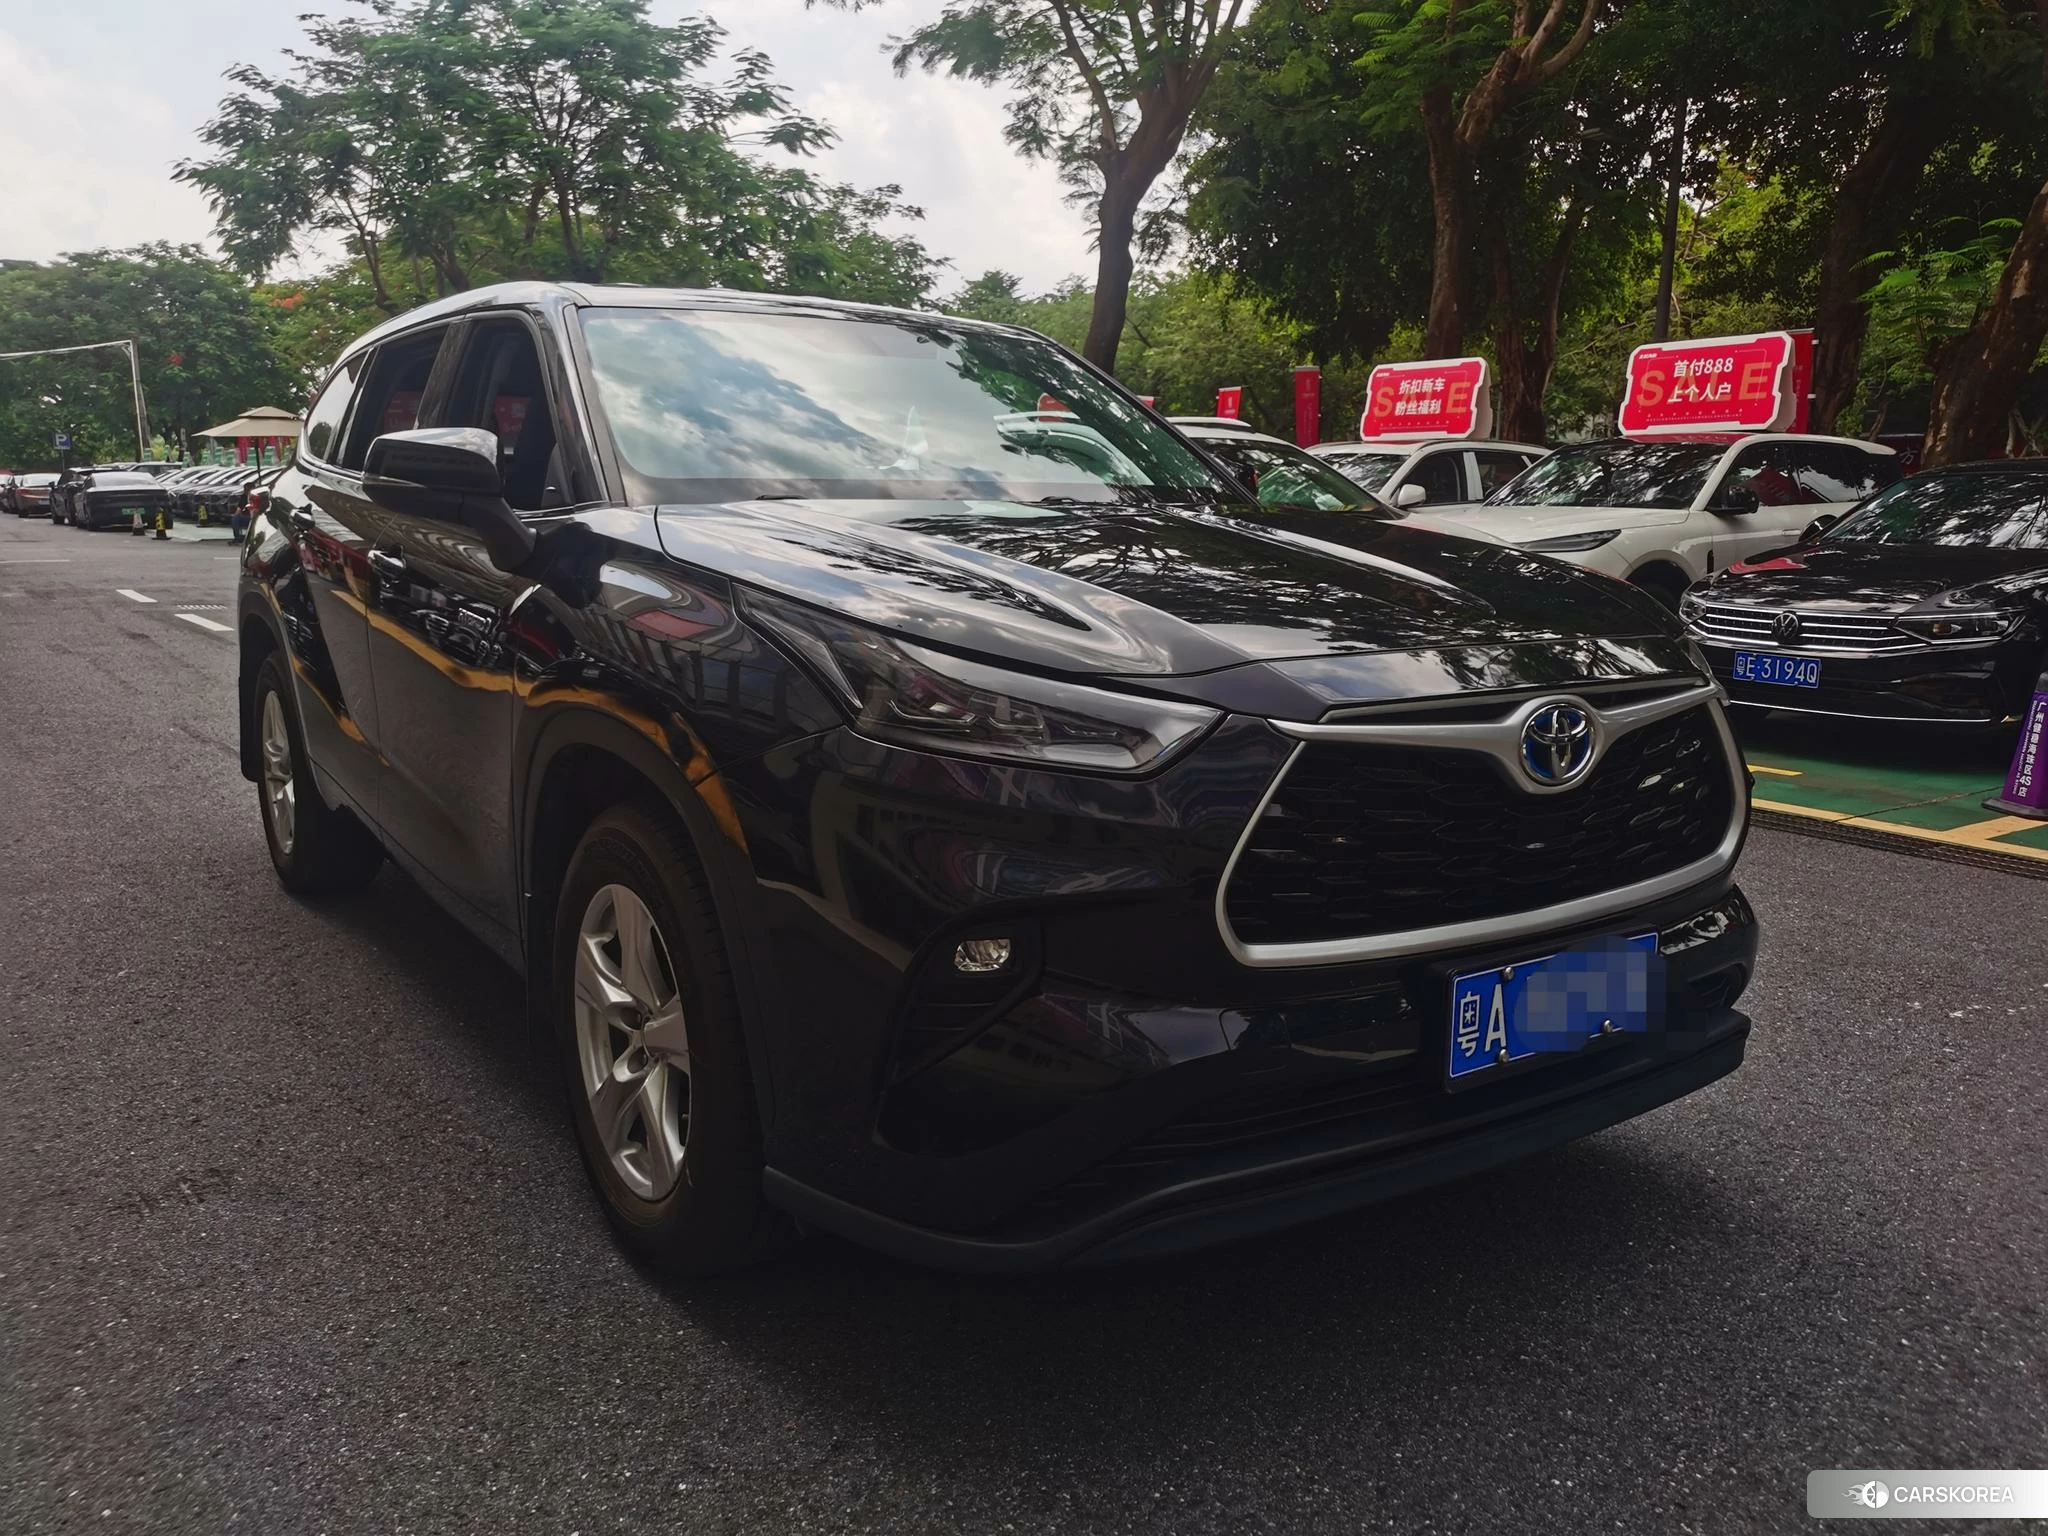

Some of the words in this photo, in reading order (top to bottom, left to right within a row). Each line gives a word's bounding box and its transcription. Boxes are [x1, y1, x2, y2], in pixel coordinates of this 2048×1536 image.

[1673, 357, 1734, 378] 首付888
[1398, 377, 1446, 395] 折扣新车
[1667, 382, 1732, 403] 上个人户
[1394, 399, 1442, 416] 粉丝福利
